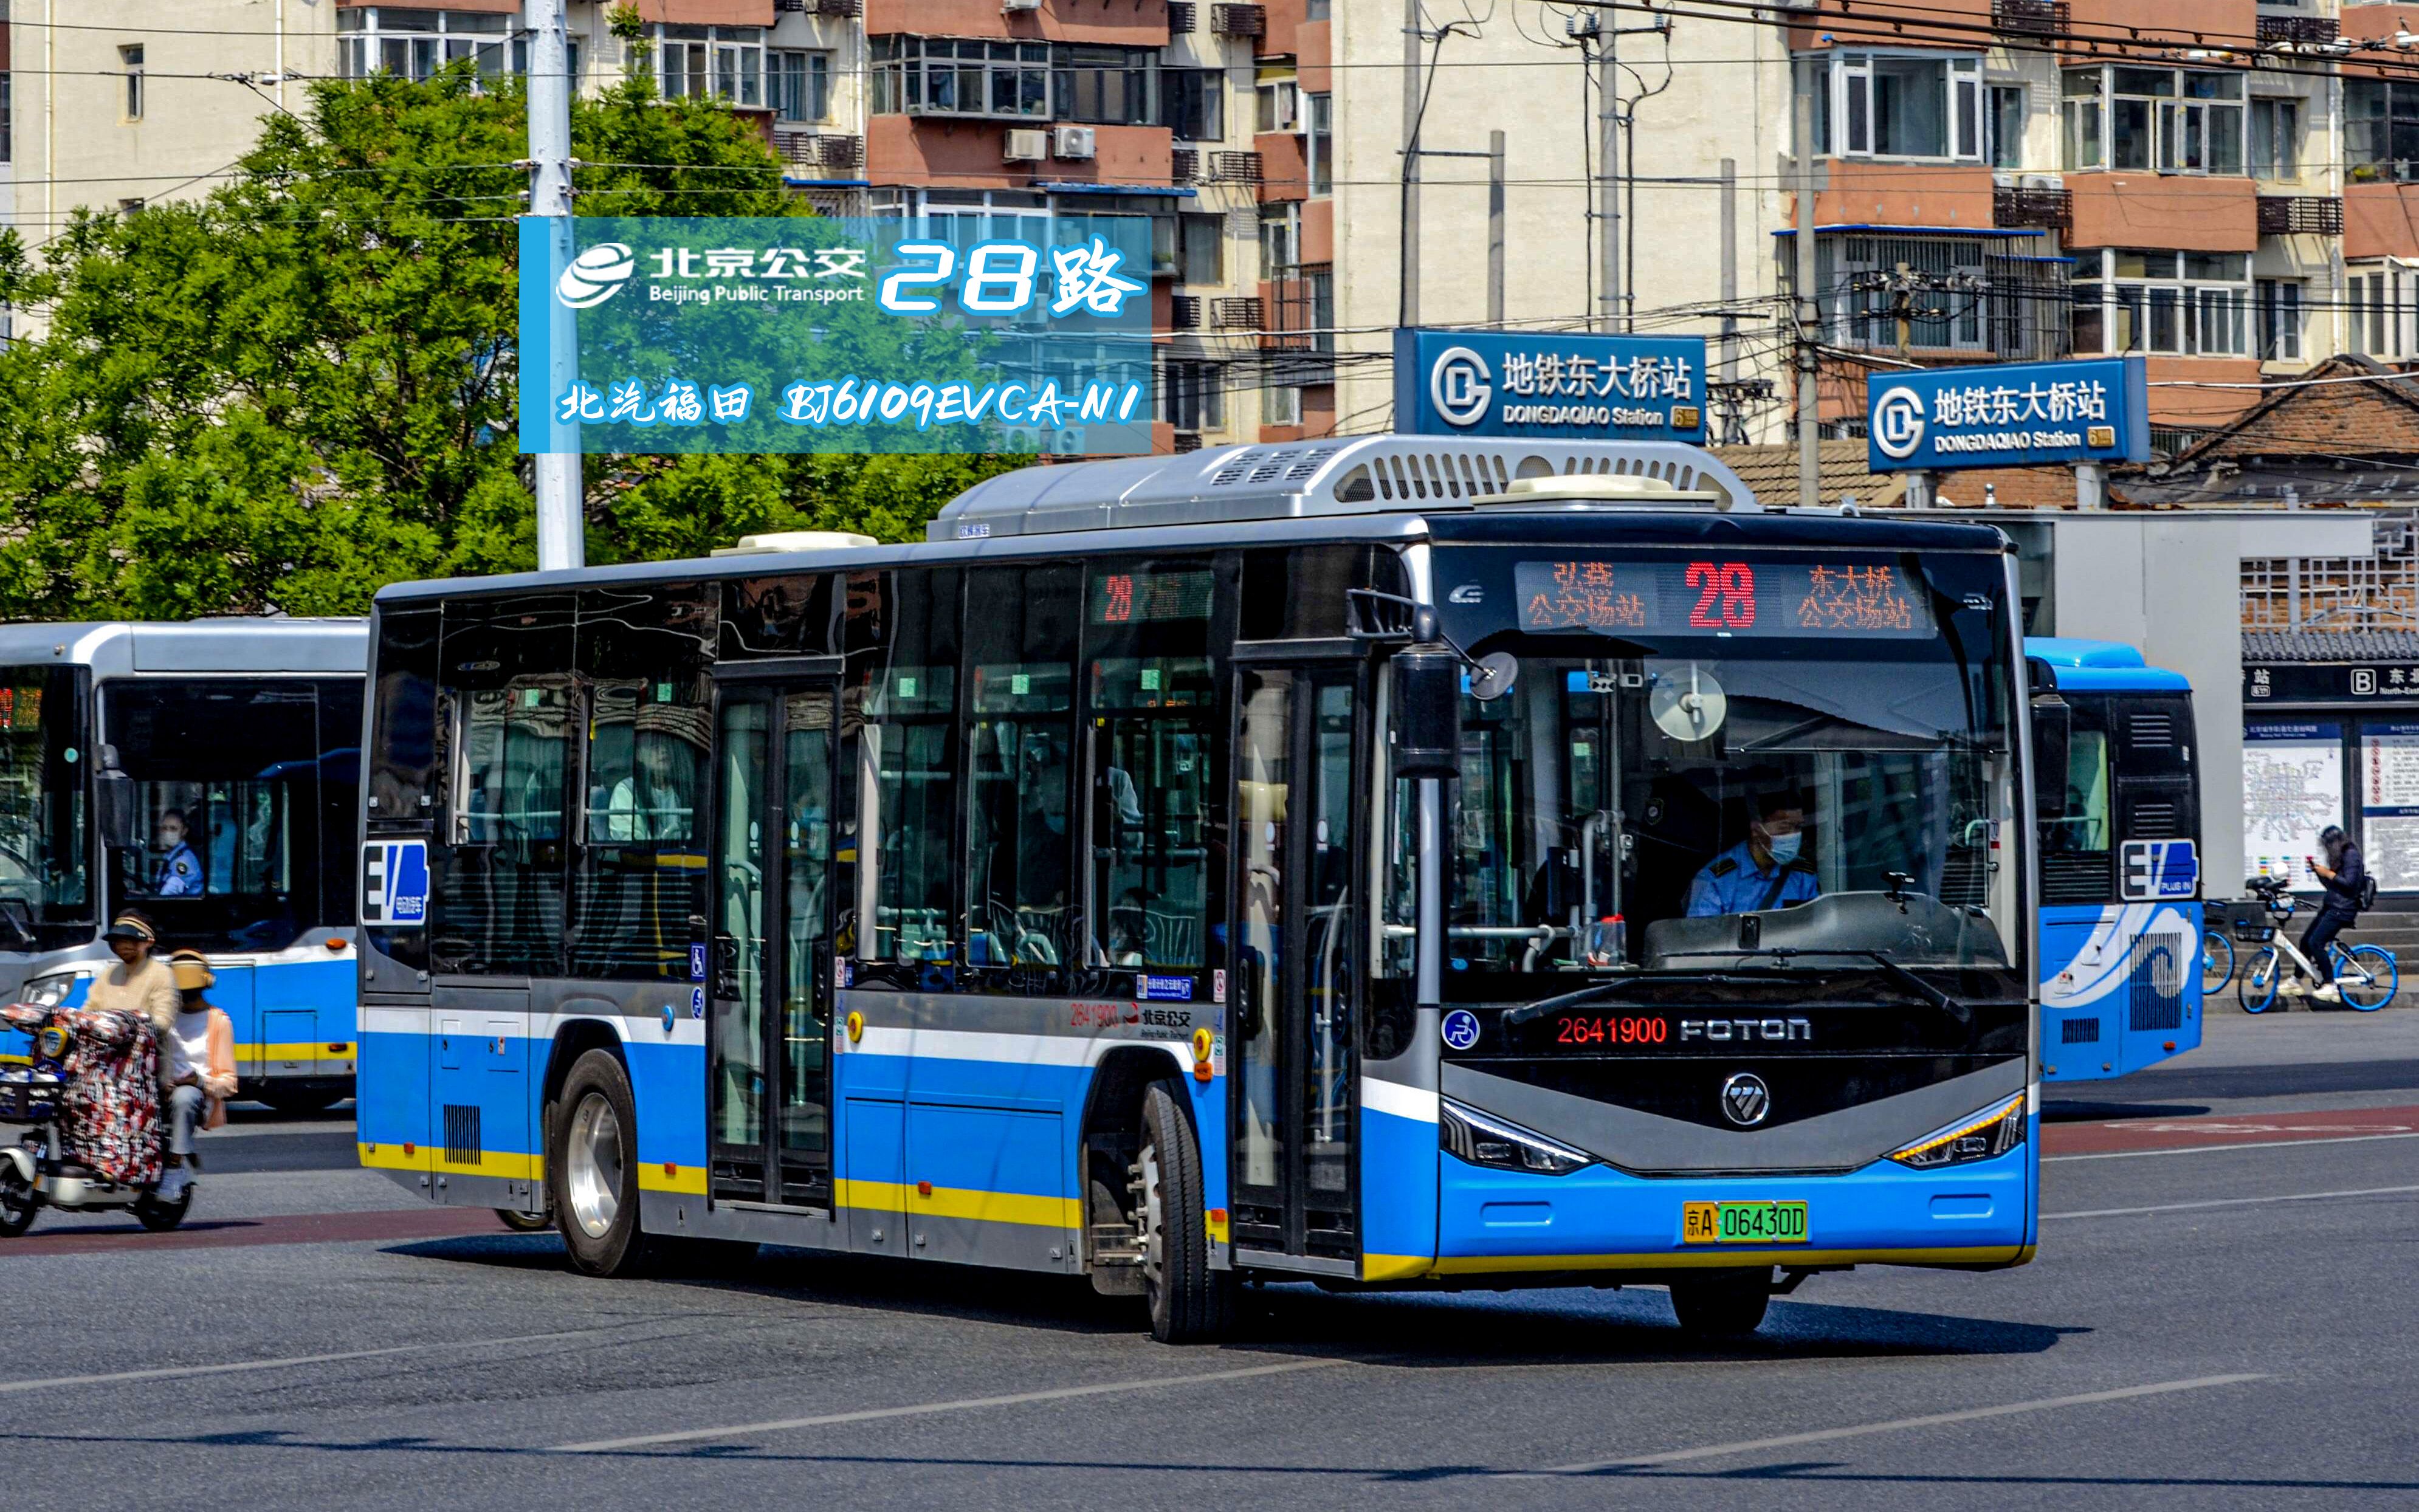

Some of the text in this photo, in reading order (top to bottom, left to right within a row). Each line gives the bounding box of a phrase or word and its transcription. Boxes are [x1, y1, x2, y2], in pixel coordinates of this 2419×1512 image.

[1502, 352, 1692, 400] 地铁东大桥站
[1502, 405, 1608, 425] DONGDAQIAO
[1612, 408, 1663, 426] Station
[1933, 380, 2107, 426] 地铁东大桥站
[1935, 433, 2031, 453] DONGDAQIAO
[2032, 430, 2081, 448] Station
[1104, 575, 1133, 621] 28
[1685, 562, 1757, 628] 28
[1808, 565, 1896, 600] 东大桥
[1528, 593, 1645, 627] 公交场站
[1798, 596, 1911, 630] 公交场站
[2355, 672, 2372, 692] B
[1142, 1009, 1191, 1027] 北京公交
[1557, 1017, 1667, 1043] 2641900
[1681, 1018, 1811, 1041] FOTON
